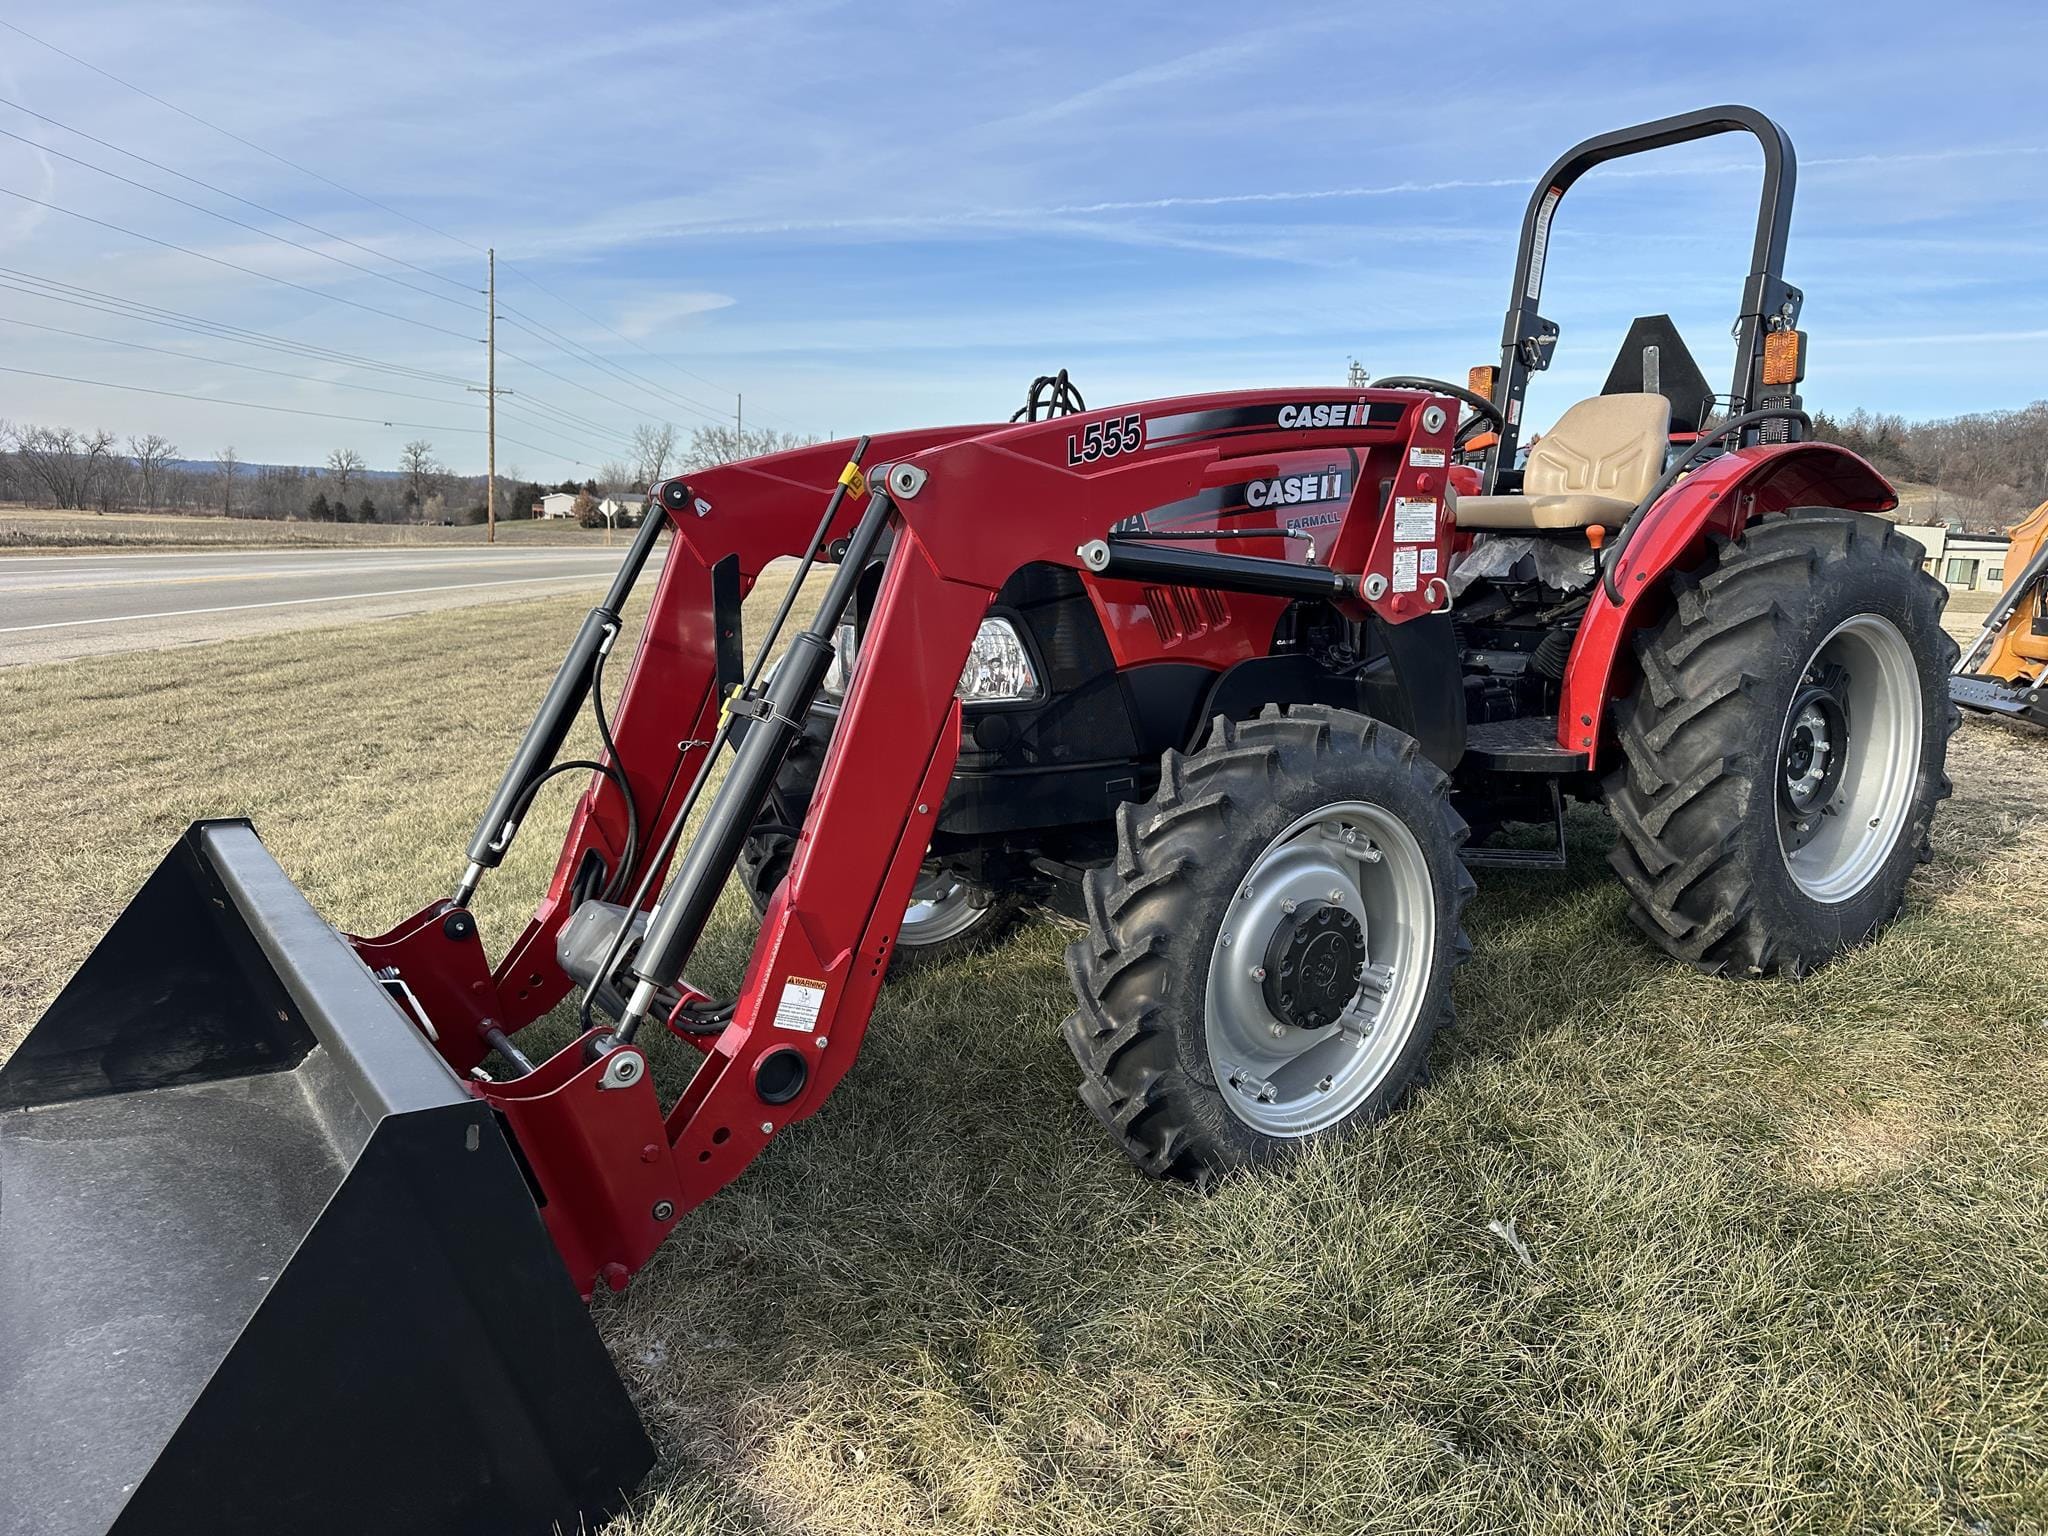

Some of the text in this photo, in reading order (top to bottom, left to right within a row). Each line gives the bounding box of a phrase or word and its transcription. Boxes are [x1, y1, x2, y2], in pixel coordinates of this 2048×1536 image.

[1278, 405, 1347, 429] CASE
[1067, 413, 1142, 467] L555
[1247, 477, 1318, 507] CASE
[1286, 511, 1341, 529] FARMALL
[795, 977, 826, 990] WARNING
